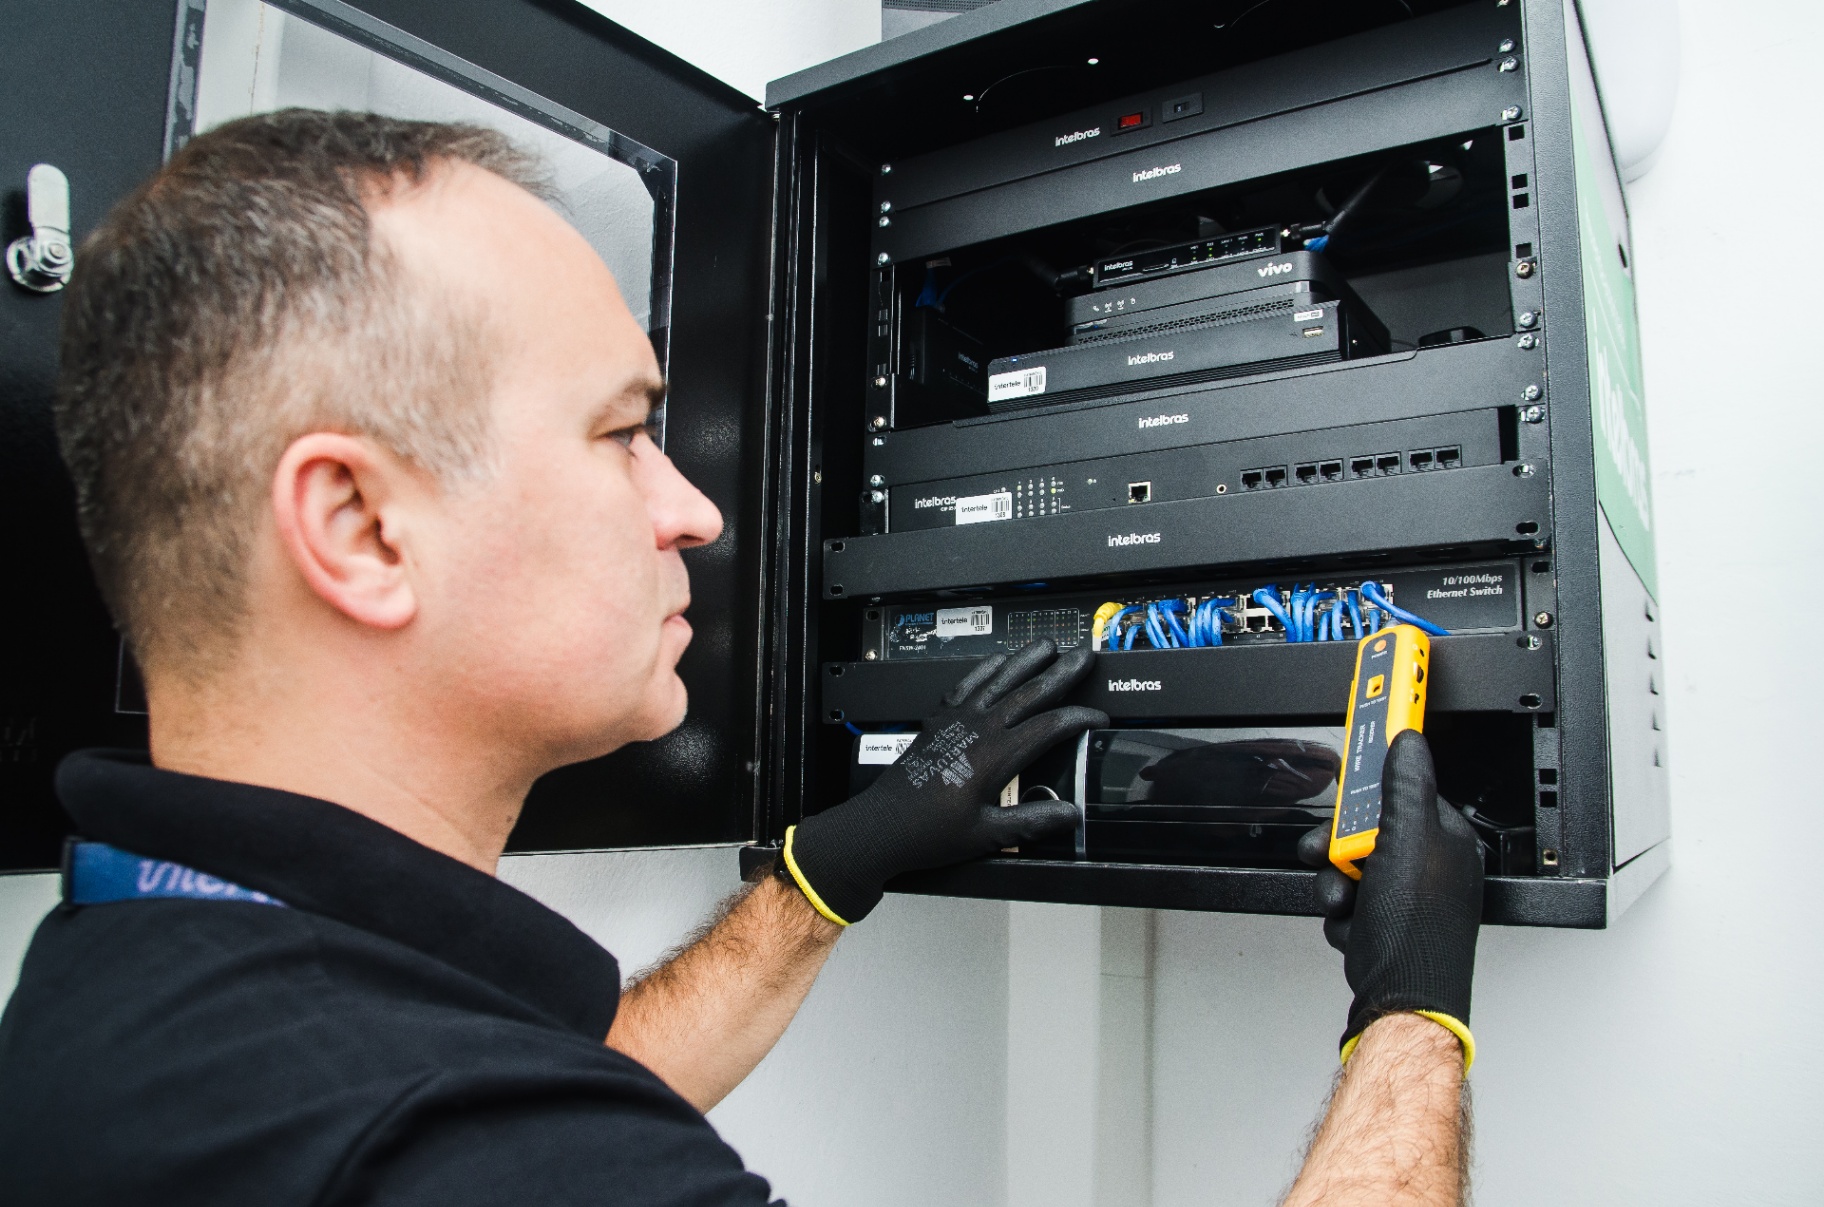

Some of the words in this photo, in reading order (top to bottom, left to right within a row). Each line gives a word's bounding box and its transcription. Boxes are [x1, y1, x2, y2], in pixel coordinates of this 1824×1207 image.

[1055, 127, 1100, 147] intelbras
[1133, 163, 1182, 182] intelbras
[1257, 262, 1293, 277] vivo
[1127, 351, 1175, 367] intelbras
[1138, 411, 1189, 428] intelbras
[914, 495, 957, 509] intelbras
[1108, 532, 1161, 548] intelbras
[1442, 573, 1503, 586] 10/100Mbps
[1427, 586, 1468, 600] Ethernet
[1469, 585, 1503, 597] Switch
[905, 612, 935, 623] PLANET
[1108, 678, 1162, 693] intelbras
